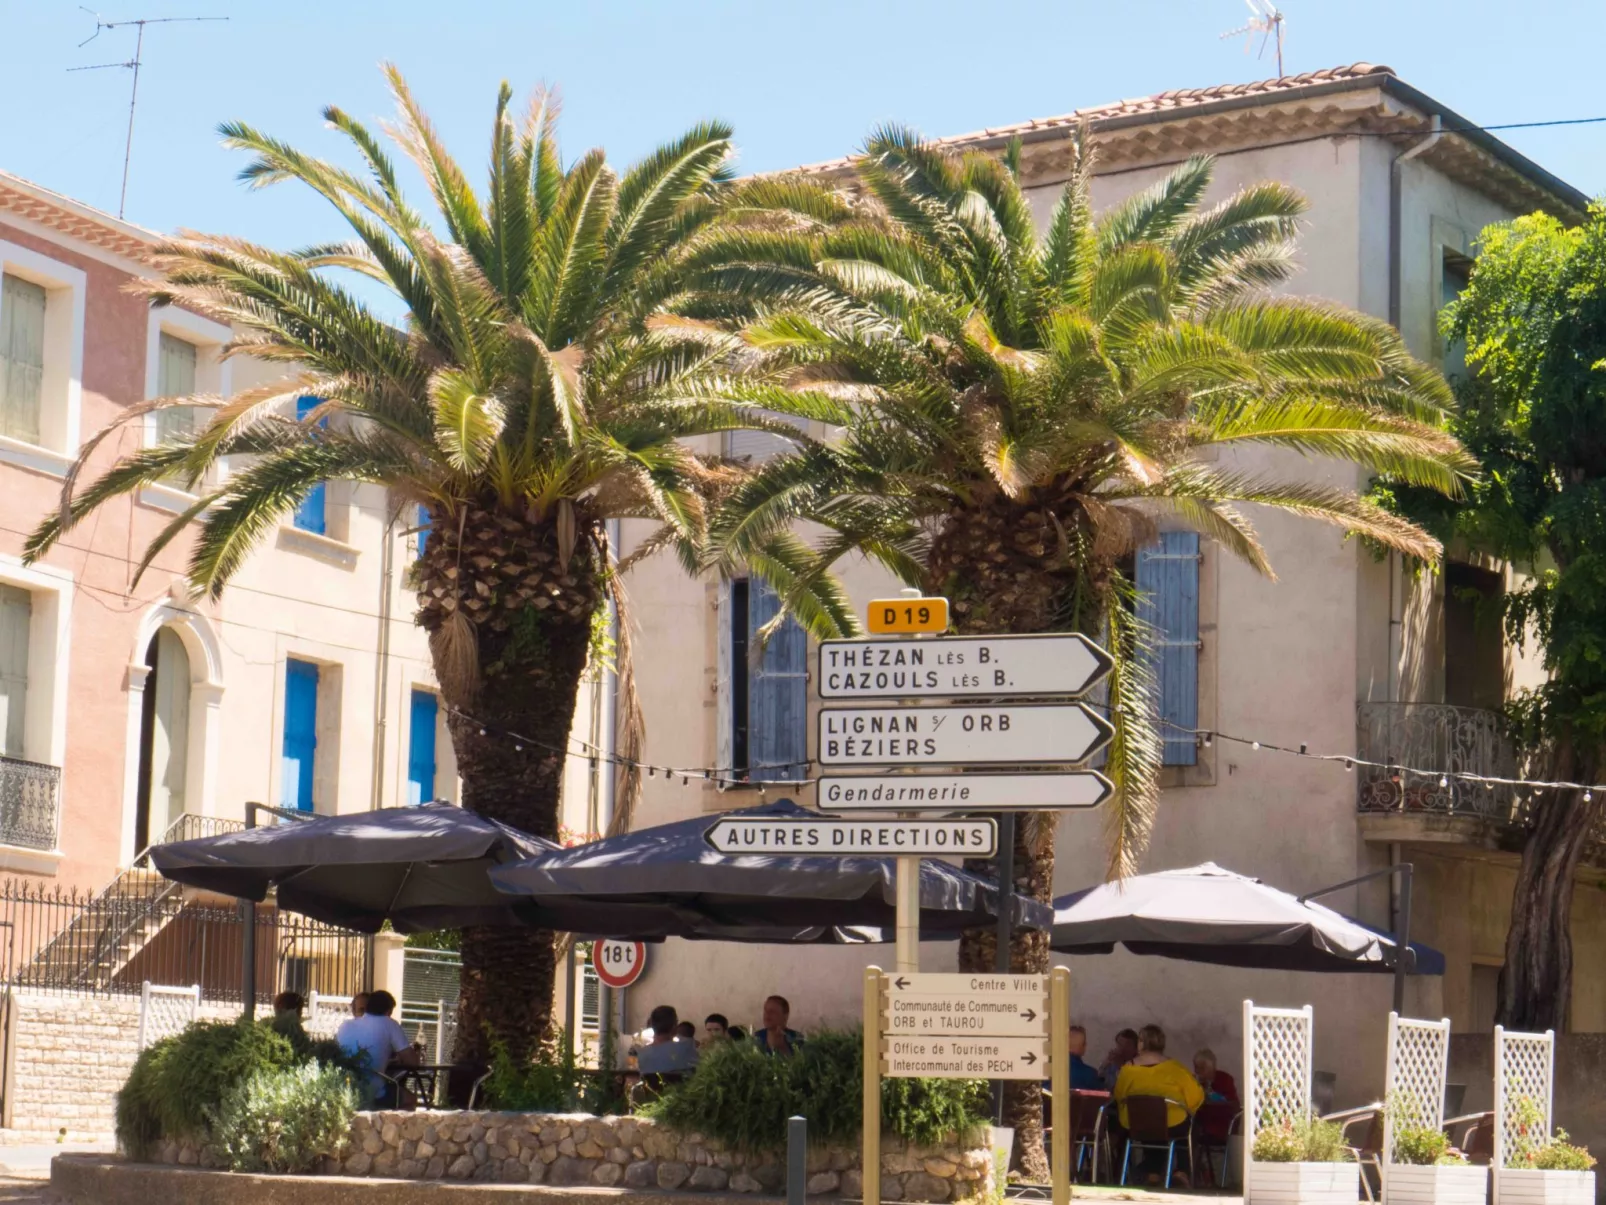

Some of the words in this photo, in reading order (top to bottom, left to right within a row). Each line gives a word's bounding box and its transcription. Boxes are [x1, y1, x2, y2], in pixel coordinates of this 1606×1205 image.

[829, 647, 924, 667] THÉZAN
[979, 648, 999, 663] B.
[828, 672, 938, 690] CAZOULS
[994, 670, 1013, 686] B.
[828, 716, 919, 734] LIGNAN
[962, 715, 1011, 731] ORB
[828, 736, 936, 757] BÉZIERS
[828, 784, 970, 801] Gendarmerie
[728, 829, 820, 845] AUTRES
[832, 829, 983, 846] DIRECTIONS
[971, 979, 1006, 990] Centre
[1013, 979, 1037, 991] Ville
[894, 1000, 951, 1012] Communauté
[955, 1001, 965, 1012] de
[969, 1001, 1017, 1012] Communes
[894, 1017, 915, 1027] ORB
[923, 1017, 932, 1027] et
[941, 1017, 984, 1028] TAUROU
[894, 1043, 925, 1054] Office
[932, 1044, 944, 1054] de
[952, 1044, 998, 1055] Tourisme
[894, 1060, 963, 1071] Intercommunal
[967, 1060, 983, 1071] des
[988, 1061, 1013, 1072] PECH
